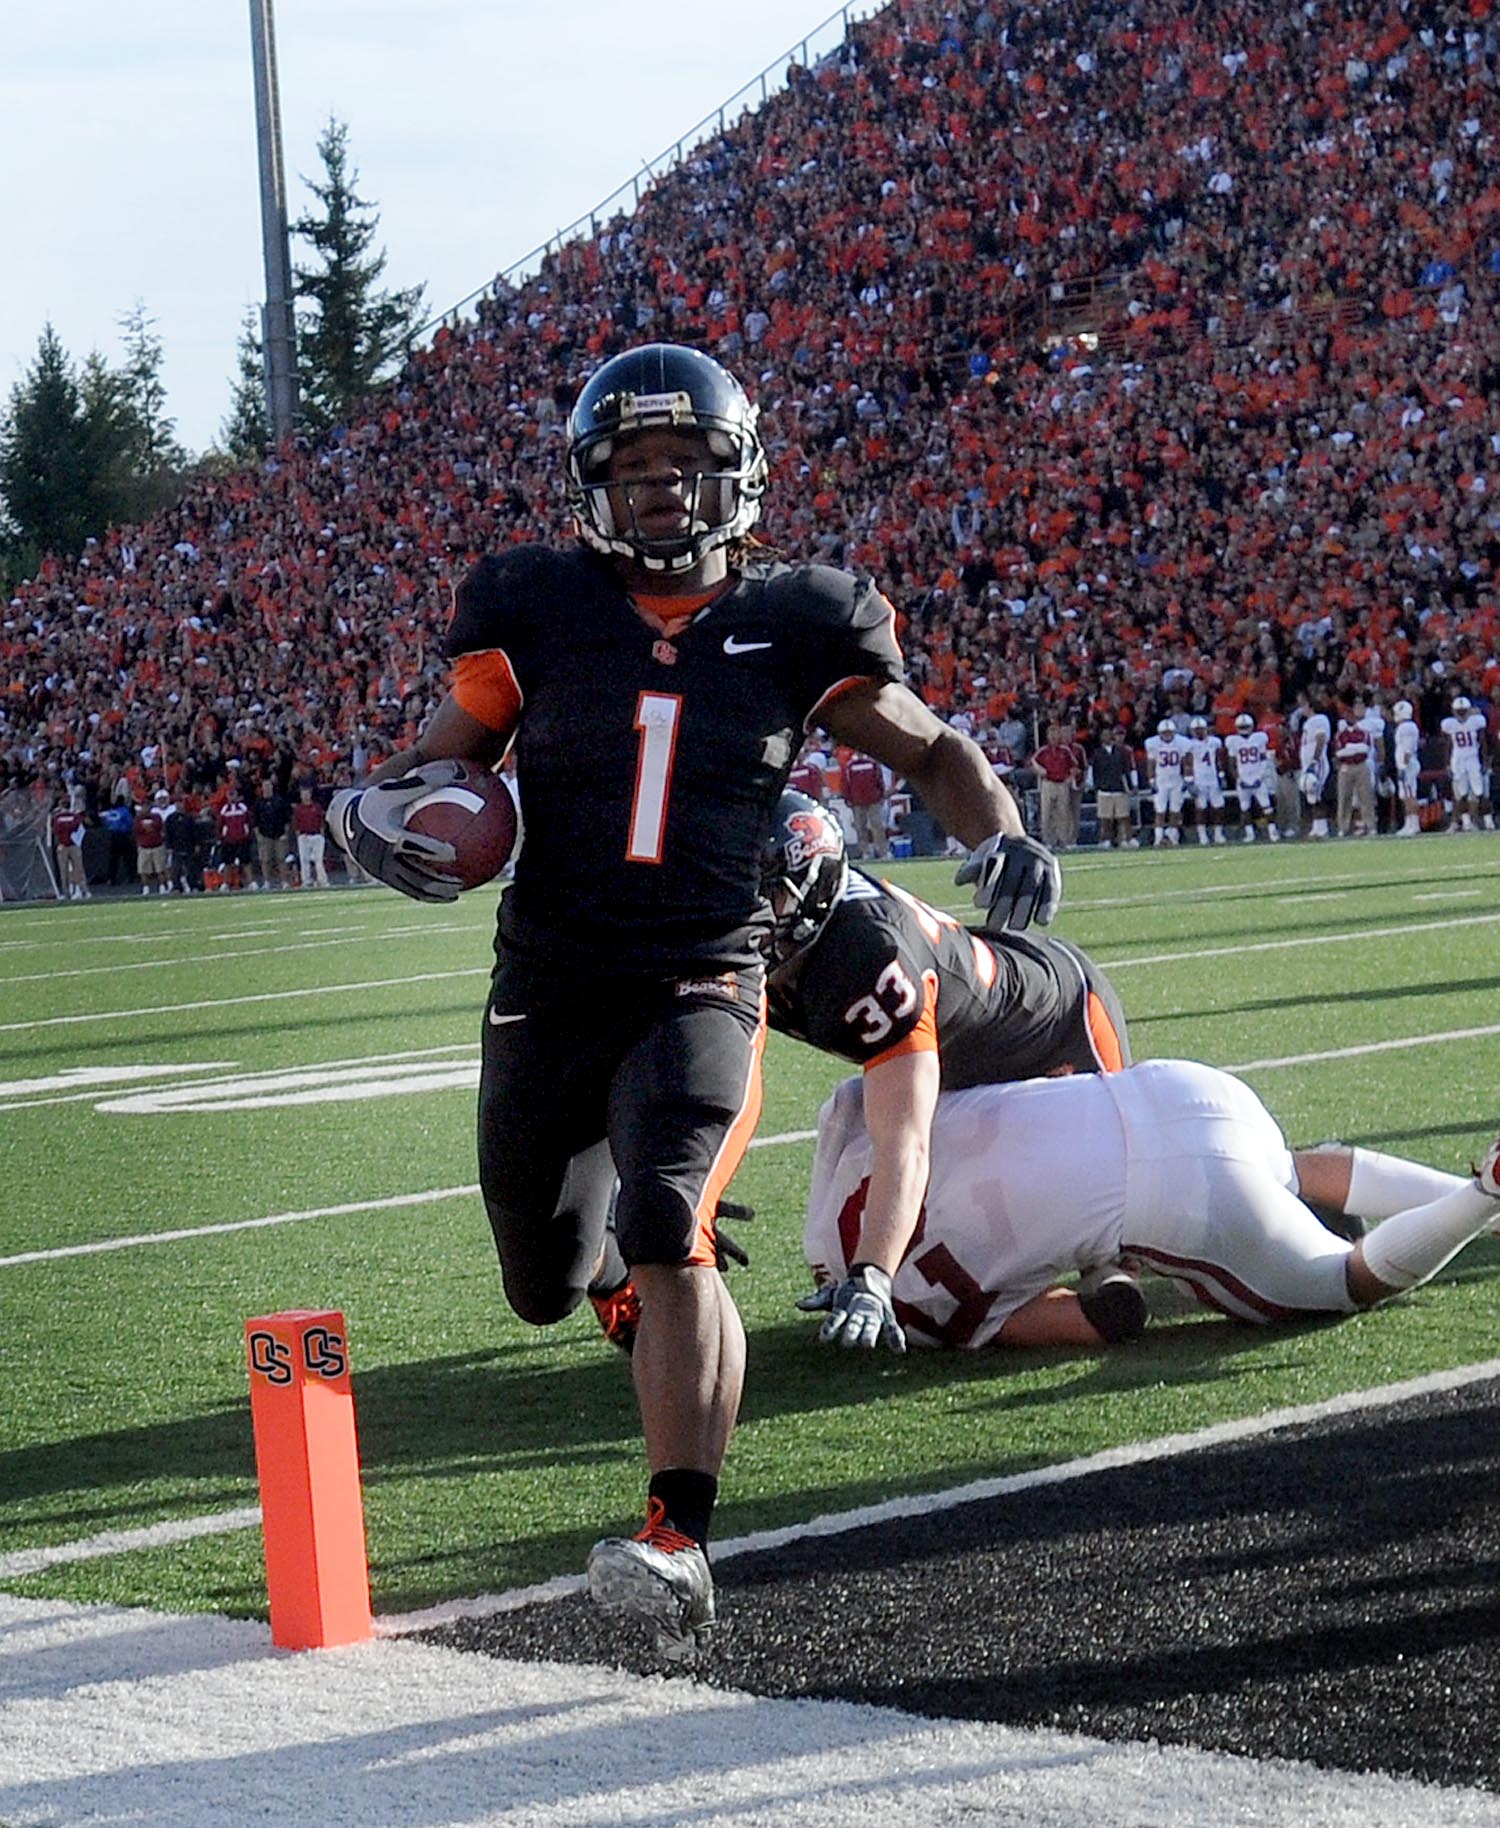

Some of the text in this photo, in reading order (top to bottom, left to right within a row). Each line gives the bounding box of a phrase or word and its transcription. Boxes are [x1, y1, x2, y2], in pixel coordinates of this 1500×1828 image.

[1455, 730, 1475, 748] 81
[1158, 750, 1180, 768] 30
[1201, 751, 1212, 767] 4
[1238, 746, 1260, 765] 89
[626, 690, 685, 865] 1
[845, 959, 917, 1045] 33
